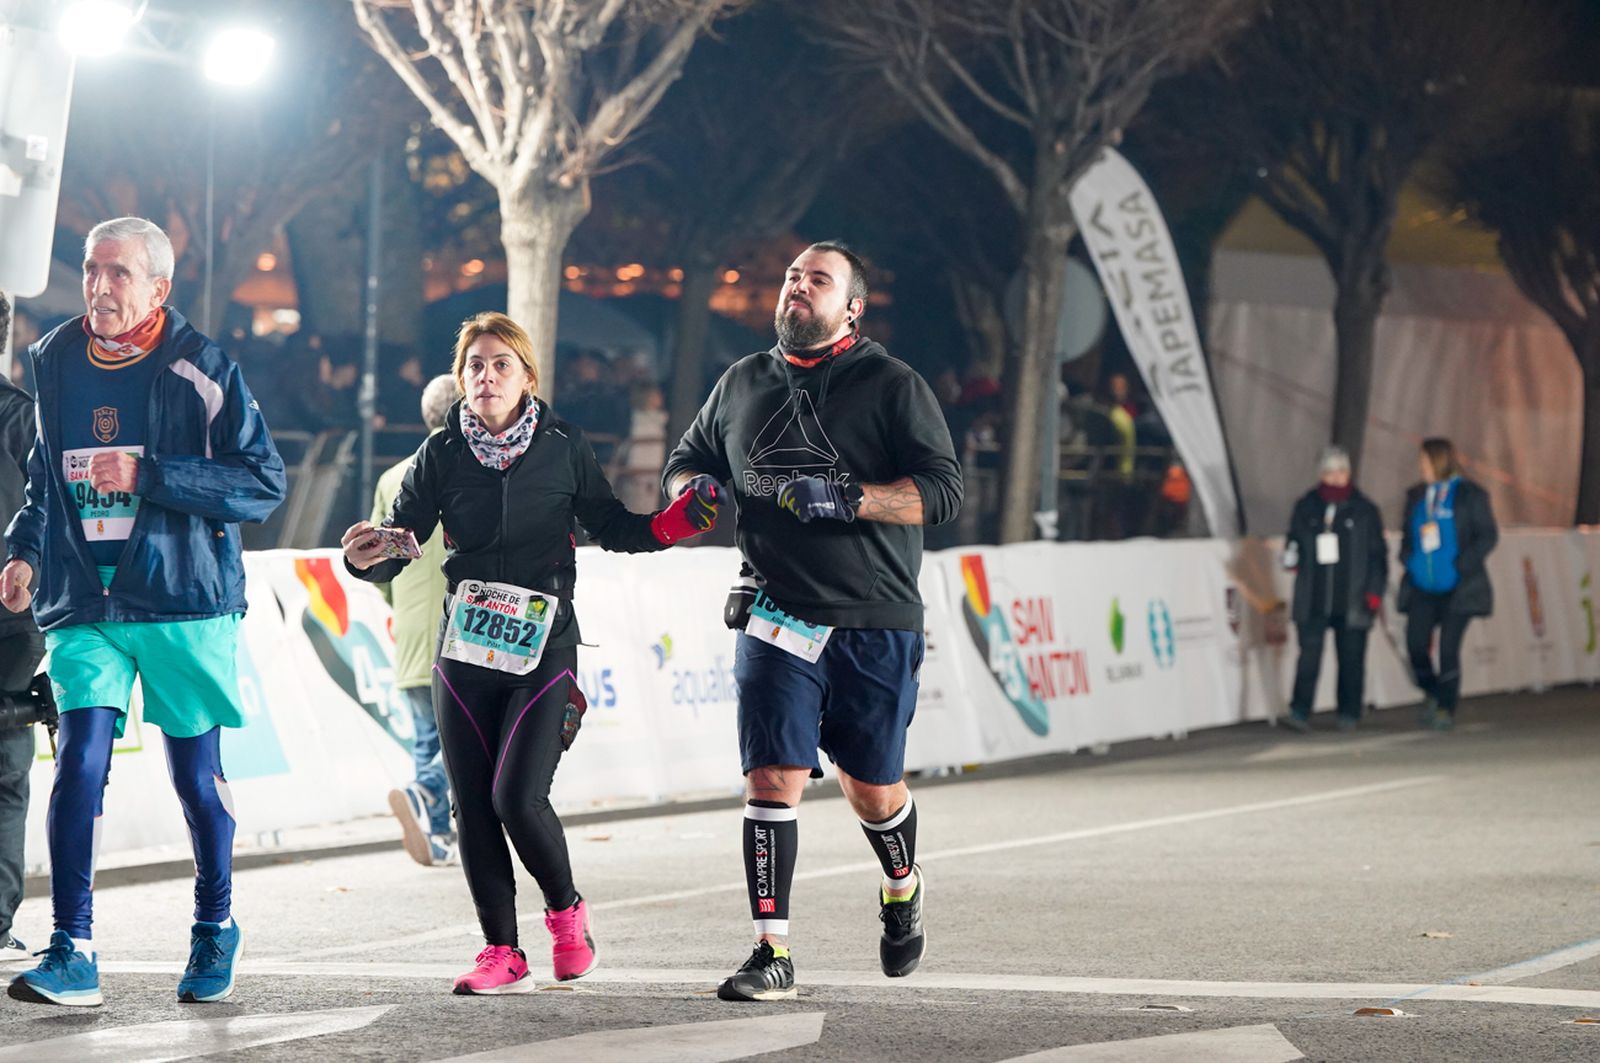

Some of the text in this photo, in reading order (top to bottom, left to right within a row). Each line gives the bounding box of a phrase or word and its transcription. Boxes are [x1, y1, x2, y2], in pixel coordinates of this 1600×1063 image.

[1118, 190, 1203, 397] JAPEMASA
[480, 588, 508, 603] NOCHE
[508, 595, 521, 605] DE
[463, 607, 537, 648] 12852
[1013, 597, 1054, 645] SAN
